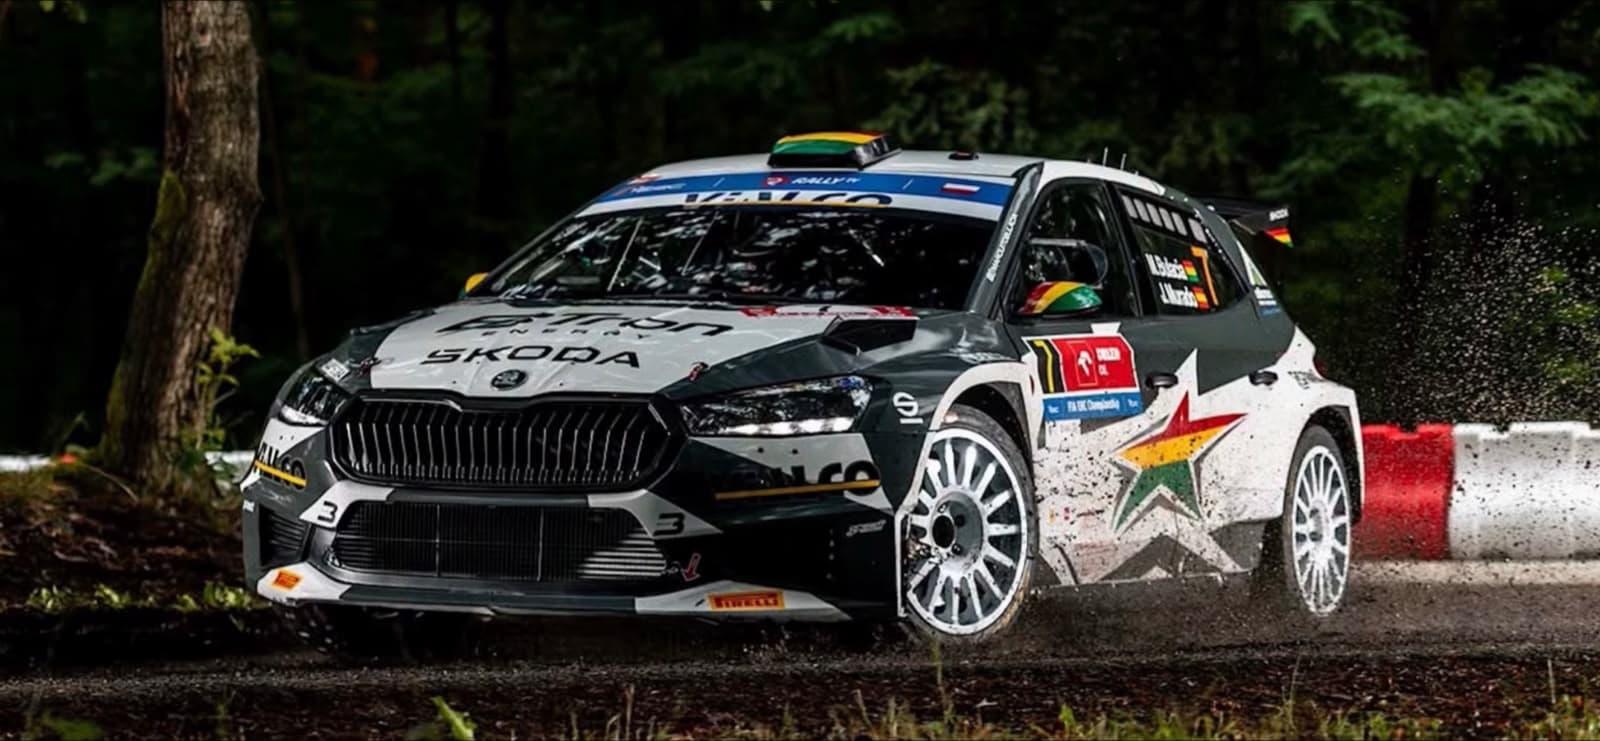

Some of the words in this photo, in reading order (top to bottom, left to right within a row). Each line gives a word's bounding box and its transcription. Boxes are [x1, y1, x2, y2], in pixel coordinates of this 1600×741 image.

[792, 176, 845, 185] RALLY
[1033, 339, 1055, 394] 7
[317, 500, 338, 523] 3
[652, 511, 686, 536] 3
